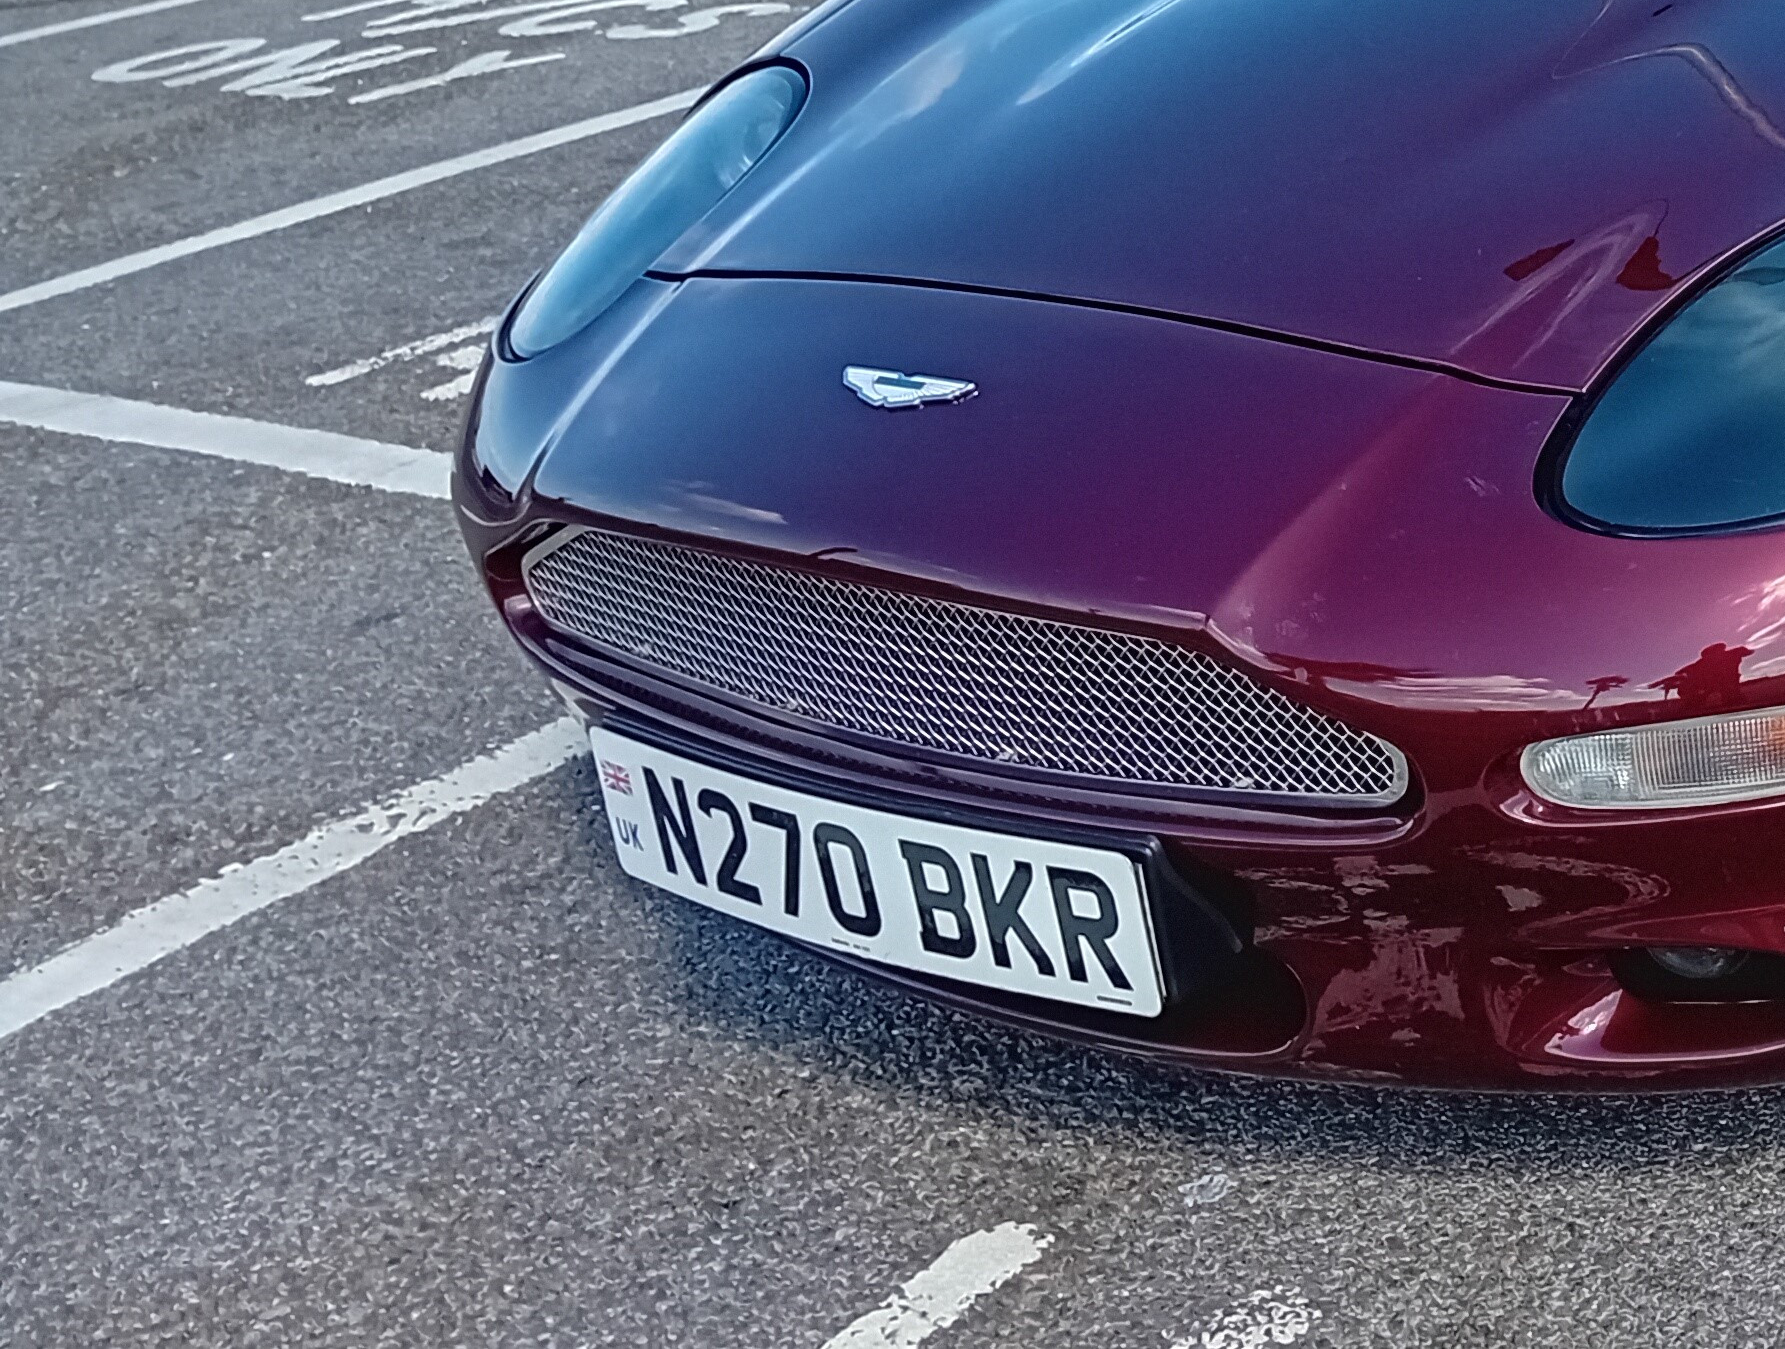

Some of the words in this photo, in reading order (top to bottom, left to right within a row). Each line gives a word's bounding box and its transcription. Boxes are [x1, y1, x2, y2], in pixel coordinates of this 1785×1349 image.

[91, 37, 567, 106] ONLY
[616, 817, 644, 853] UK
[641, 765, 884, 938] N270
[898, 838, 1134, 992] BKR
